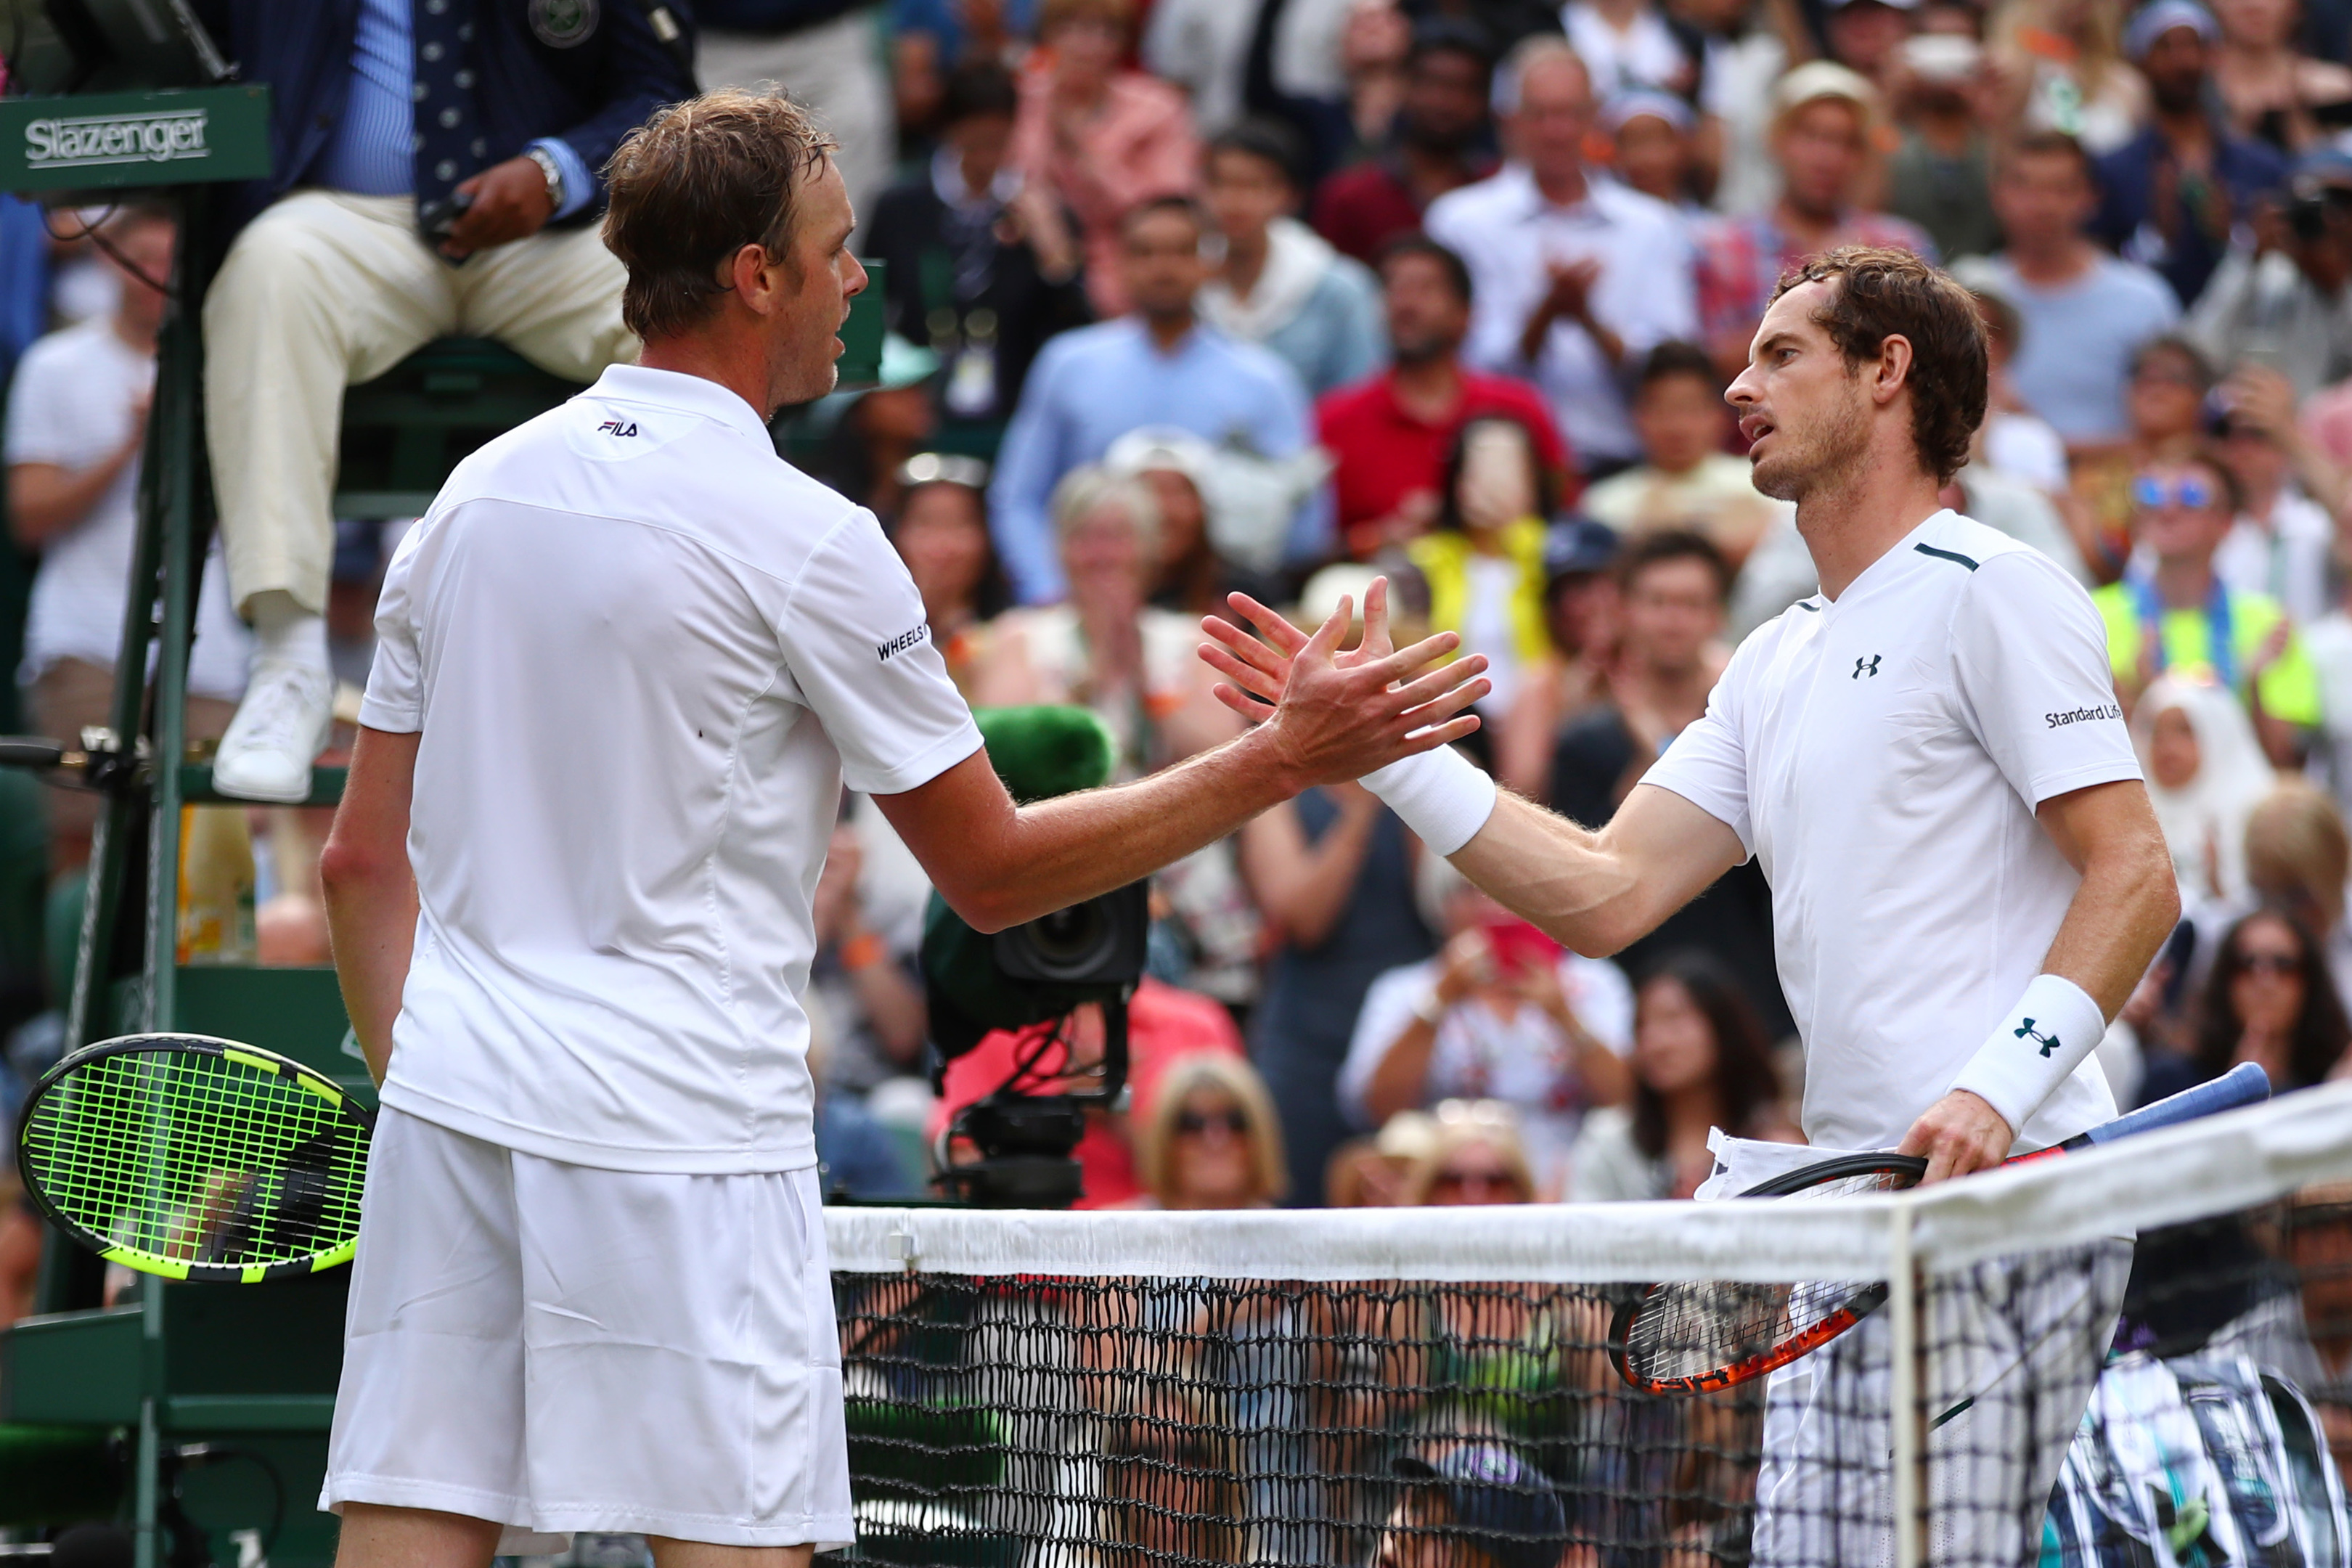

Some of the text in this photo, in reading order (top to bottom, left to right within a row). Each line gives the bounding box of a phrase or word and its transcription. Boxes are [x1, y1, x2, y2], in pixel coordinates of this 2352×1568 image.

[25, 118, 209, 162] Slazenger
[597, 421, 637, 437] FILA
[877, 626, 923, 661] WHEELS
[2045, 704, 2105, 729] Standard
